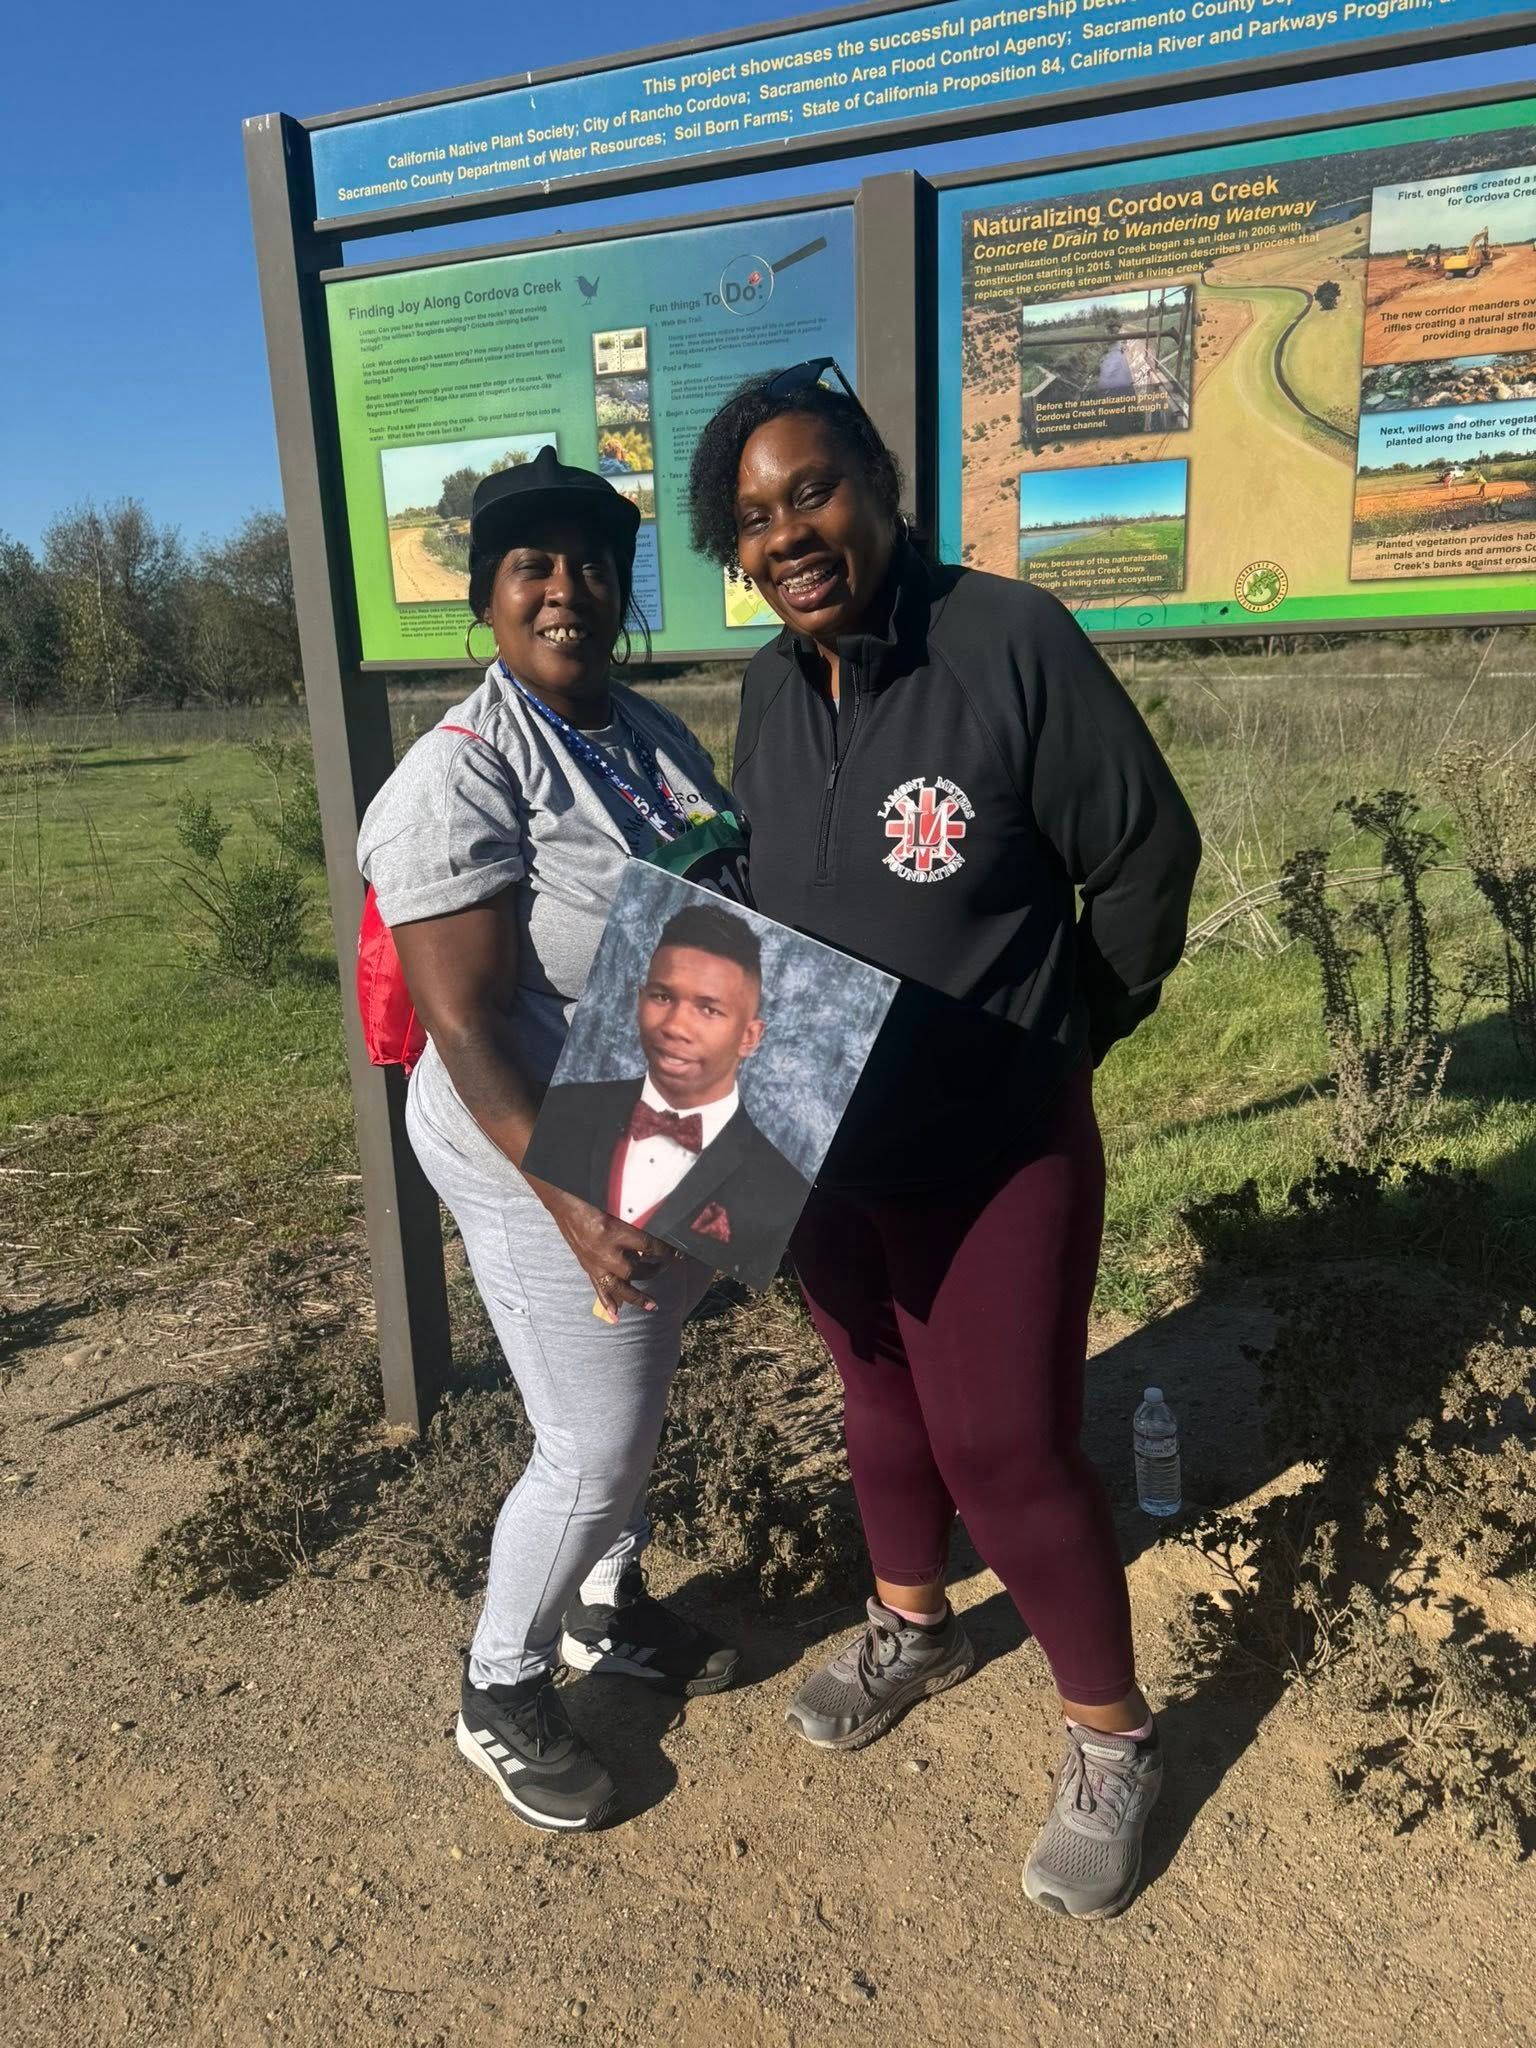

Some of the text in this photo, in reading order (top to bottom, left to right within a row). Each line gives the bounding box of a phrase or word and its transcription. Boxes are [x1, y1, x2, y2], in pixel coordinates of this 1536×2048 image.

[642, 0, 1076, 95] This project showcases the successful partnership
[387, 0, 1254, 168] California Native Plant Society; City of Rancho Cordova; Sacramento Area Flood Control Agency; Sacramento County
[337, 176, 407, 200] Sacramento
[410, 168, 454, 187] County
[457, 153, 530, 179] Department
[532, 150, 546, 165] of
[548, 145, 586, 162] Water
[590, 131, 666, 154] Resources;
[674, 122, 700, 139] Soil
[704, 118, 739, 133] Born
[743, 108, 792, 126] Farms;
[801, 98, 840, 116] State
[844, 93, 859, 108] of
[863, 80, 939, 105] California
[943, 64, 1036, 90] Proposition
[1040, 57, 1064, 73] 84,
[1070, 42, 1152, 67] California
[1157, 33, 1204, 51] River
[1209, 24, 1243, 42] and
[1249, 9, 1337, 35] Parkways
[1397, 189, 1424, 200] First,
[1426, 182, 1478, 196] engineers
[1480, 175, 1520, 188] created
[972, 176, 1278, 236] Naturalizing Cordova Creek
[1447, 191, 1509, 206] for Cordova
[973, 202, 1316, 259] Concrete Drain to Wandering Waterway
[974, 222, 1300, 274] The naturalization of Cordova Creek began as an idea in 2006 with
[974, 232, 1320, 286] construction starting in 2015. Naturalization describes a process that
[974, 288, 1013, 301] replaces
[1016, 285, 1032, 294] the
[1034, 279, 1076, 292] concrete
[1078, 275, 1111, 286] stream
[1114, 270, 1134, 281] with
[1145, 267, 1173, 277] living
[1176, 261, 1207, 273] creek.
[349, 279, 562, 320] Finding Joy Along Cordova Creek
[650, 303, 668, 313] Fun
[670, 299, 700, 313] things
[704, 292, 721, 306] To
[1379, 300, 1520, 321] The new corridor meanders
[1383, 323, 1412, 332] riffles
[1414, 317, 1456, 329] creating
[1468, 311, 1504, 322] natural
[1422, 324, 1519, 343] providing drainage
[1035, 412, 1070, 421] Cordova
[1072, 408, 1096, 417] Creek
[1098, 405, 1126, 415] flowed
[1127, 402, 1160, 412] through
[1036, 402, 1063, 411] Before
[1064, 400, 1077, 408] the
[1080, 394, 1136, 406] naturalization
[1035, 419, 1108, 434] concrete channel.
[1379, 418, 1496, 435] Next, willows and other
[1386, 428, 1519, 449] planted along the banks of
[1376, 538, 1412, 548] Planted
[1415, 535, 1466, 547] vegetation
[1469, 532, 1514, 544] provides
[1051, 559, 1084, 567] because
[1086, 557, 1094, 565] of
[1096, 556, 1109, 564] the
[1111, 553, 1168, 563] naturalization
[1374, 549, 1413, 559] animals
[1415, 548, 1434, 557] and
[1436, 547, 1461, 556] birds
[1464, 545, 1483, 554] and
[1485, 544, 1521, 553] armors
[1061, 568, 1095, 577] Cordova
[1097, 566, 1120, 574] Creek
[1121, 565, 1144, 573] flows
[1393, 555, 1502, 570] Creek's banks against
[1068, 579, 1090, 588] living
[1092, 576, 1115, 585] creek
[1117, 574, 1164, 584] ecosystem.
[877, 777, 926, 819] LAMONT
[882, 853, 966, 882] FOUNDATION
